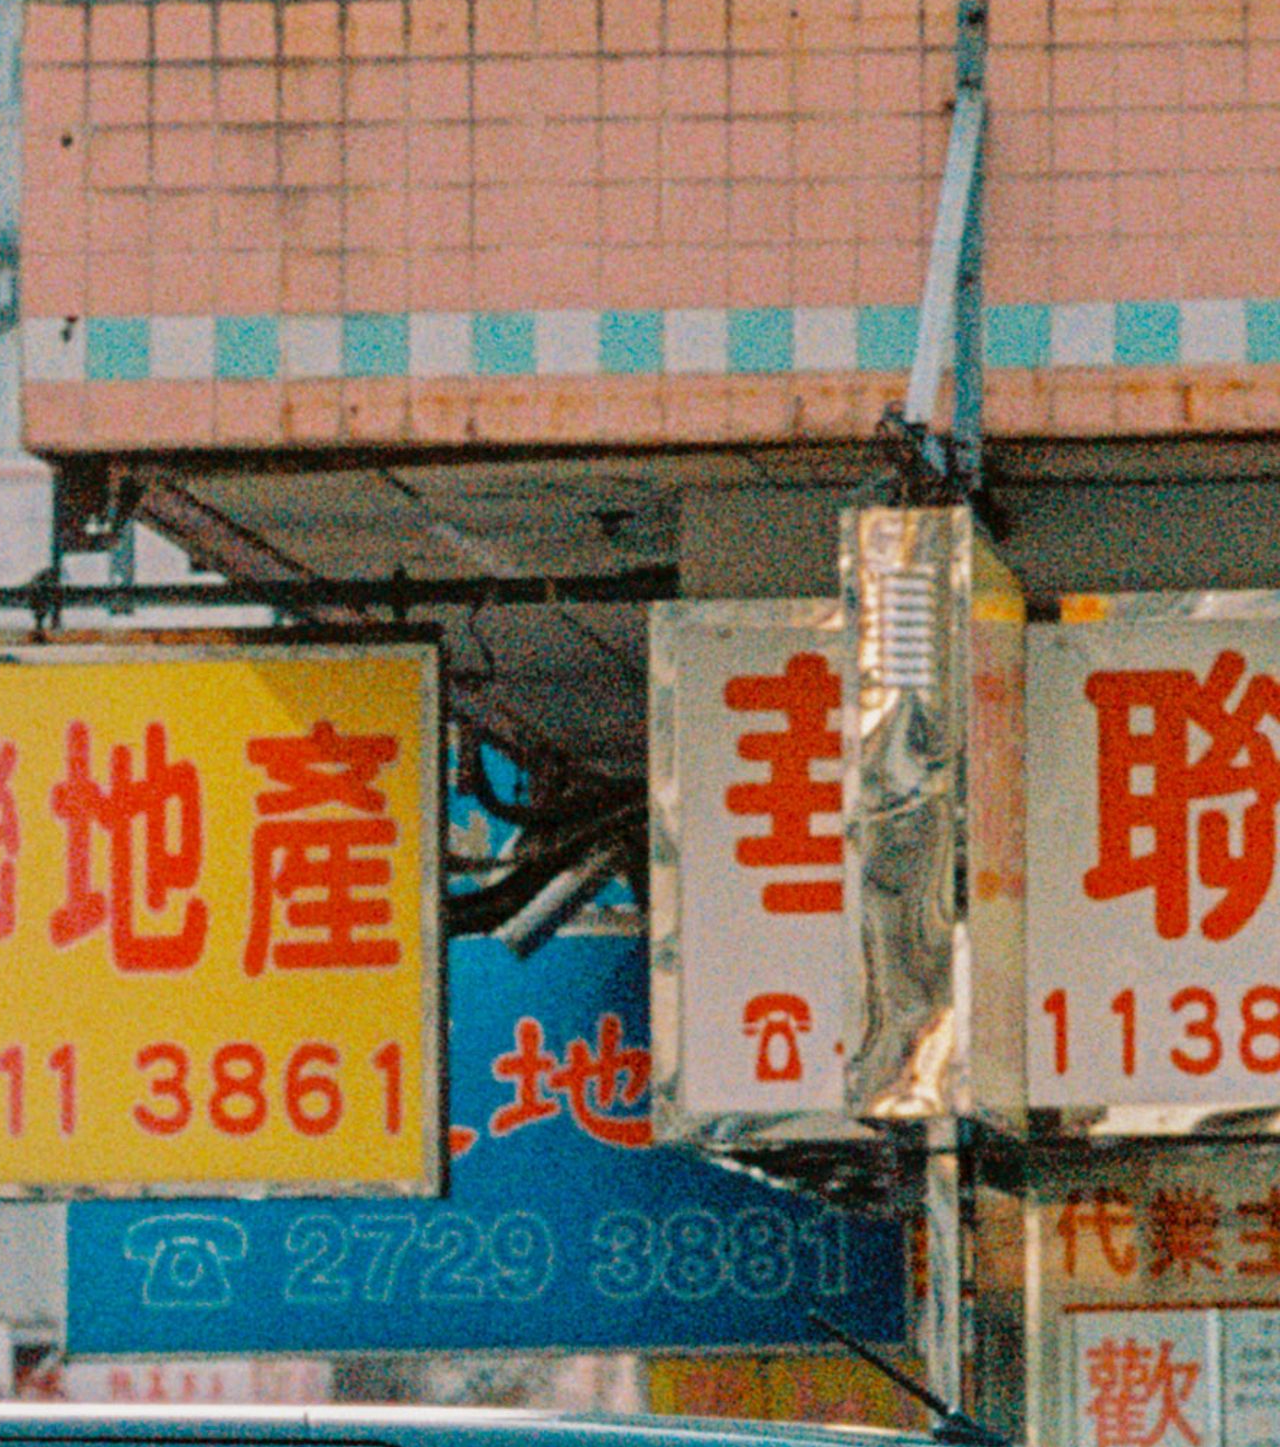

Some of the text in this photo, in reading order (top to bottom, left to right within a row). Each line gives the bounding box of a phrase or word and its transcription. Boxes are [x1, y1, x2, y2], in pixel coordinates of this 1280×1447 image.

[133, 1041, 403, 1137] 3861
[448, 1013, 652, 1151] 地
[283, 1207, 850, 1305] 2729 3881
